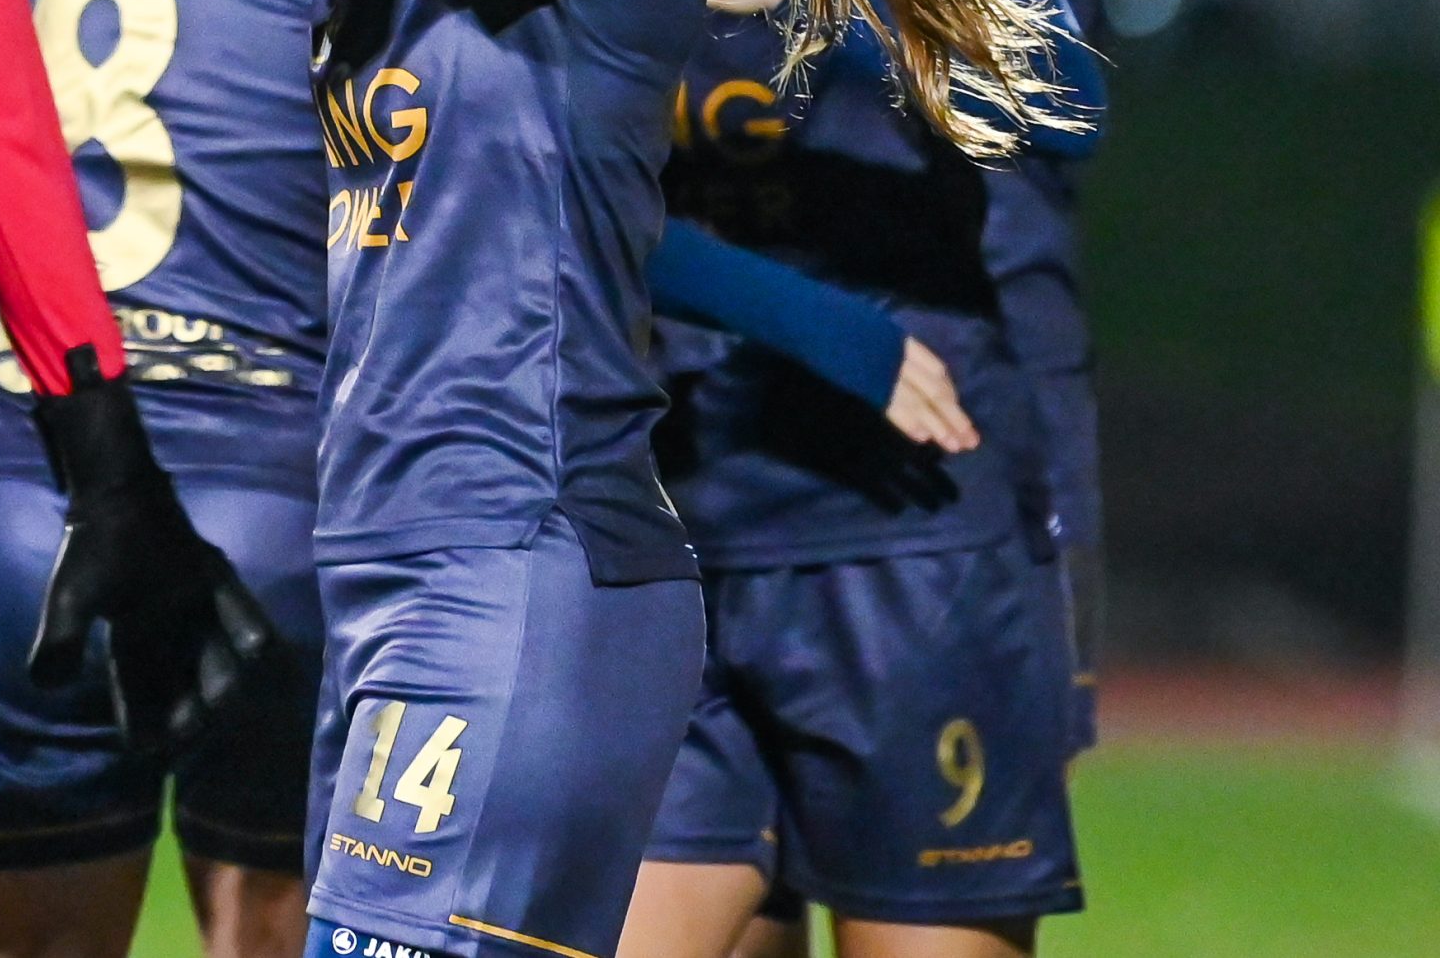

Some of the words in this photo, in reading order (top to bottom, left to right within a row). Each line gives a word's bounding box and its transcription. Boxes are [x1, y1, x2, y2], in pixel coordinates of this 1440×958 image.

[351, 698, 468, 833] 14
[936, 717, 985, 826] 9
[329, 833, 433, 878] STANNO
